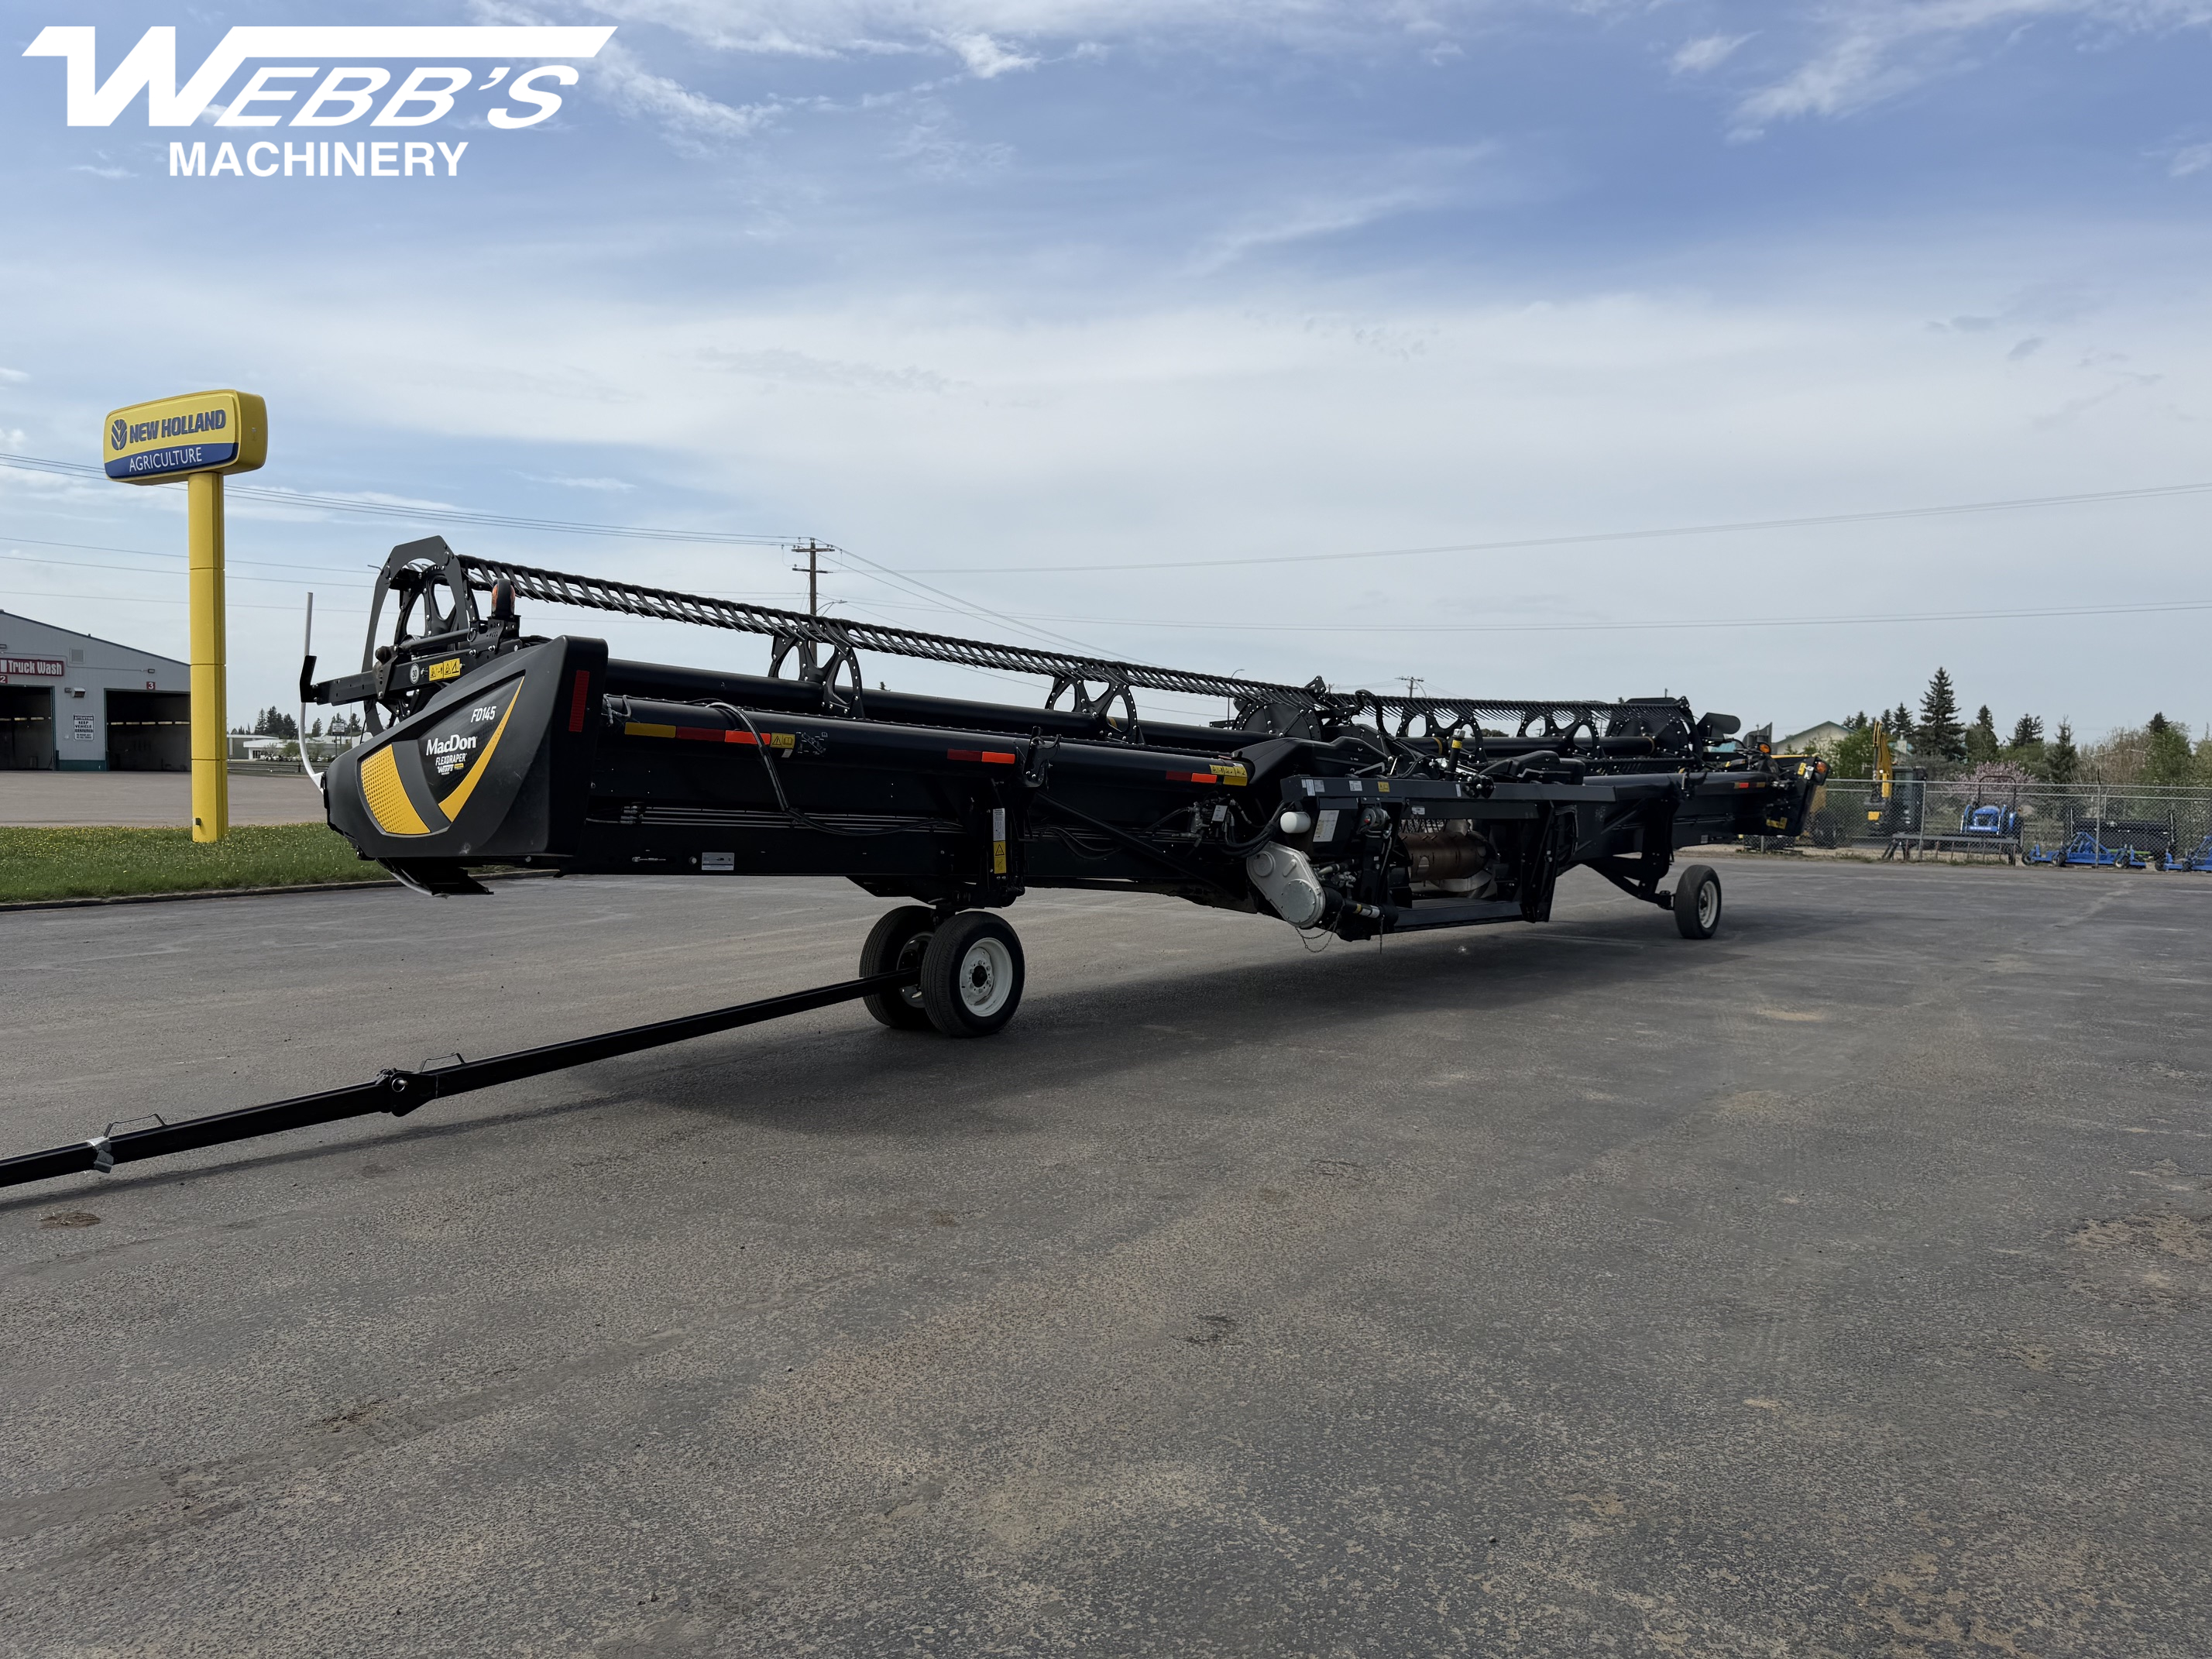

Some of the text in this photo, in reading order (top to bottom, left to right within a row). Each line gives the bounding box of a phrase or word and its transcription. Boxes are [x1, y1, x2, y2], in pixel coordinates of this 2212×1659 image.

[129, 409, 226, 443] NEW HOLLAND
[129, 447, 202, 472] AGRICULTURE
[8, 660, 62, 675] Truck Wash
[470, 706, 496, 723] FD145
[426, 734, 477, 755] MacDon
[435, 754, 466, 766] FLEXDRAPER
